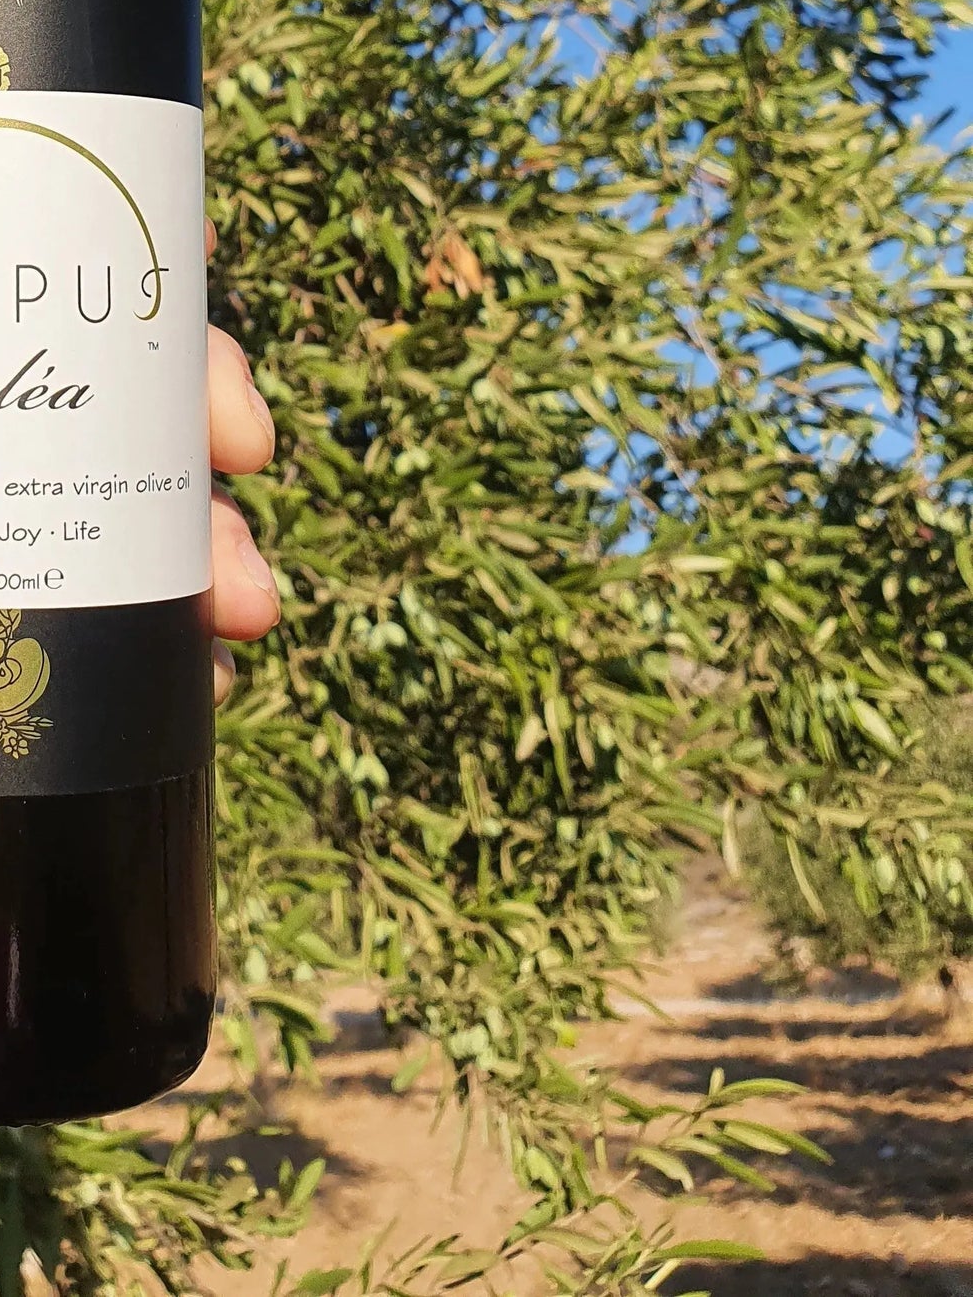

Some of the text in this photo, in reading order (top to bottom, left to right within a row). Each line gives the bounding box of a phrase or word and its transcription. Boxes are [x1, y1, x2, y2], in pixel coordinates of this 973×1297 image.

[4, 477, 64, 497] extra
[73, 474, 129, 502] virgin
[135, 472, 173, 494] olive
[176, 470, 191, 491] oil
[63, 520, 102, 542] Life
